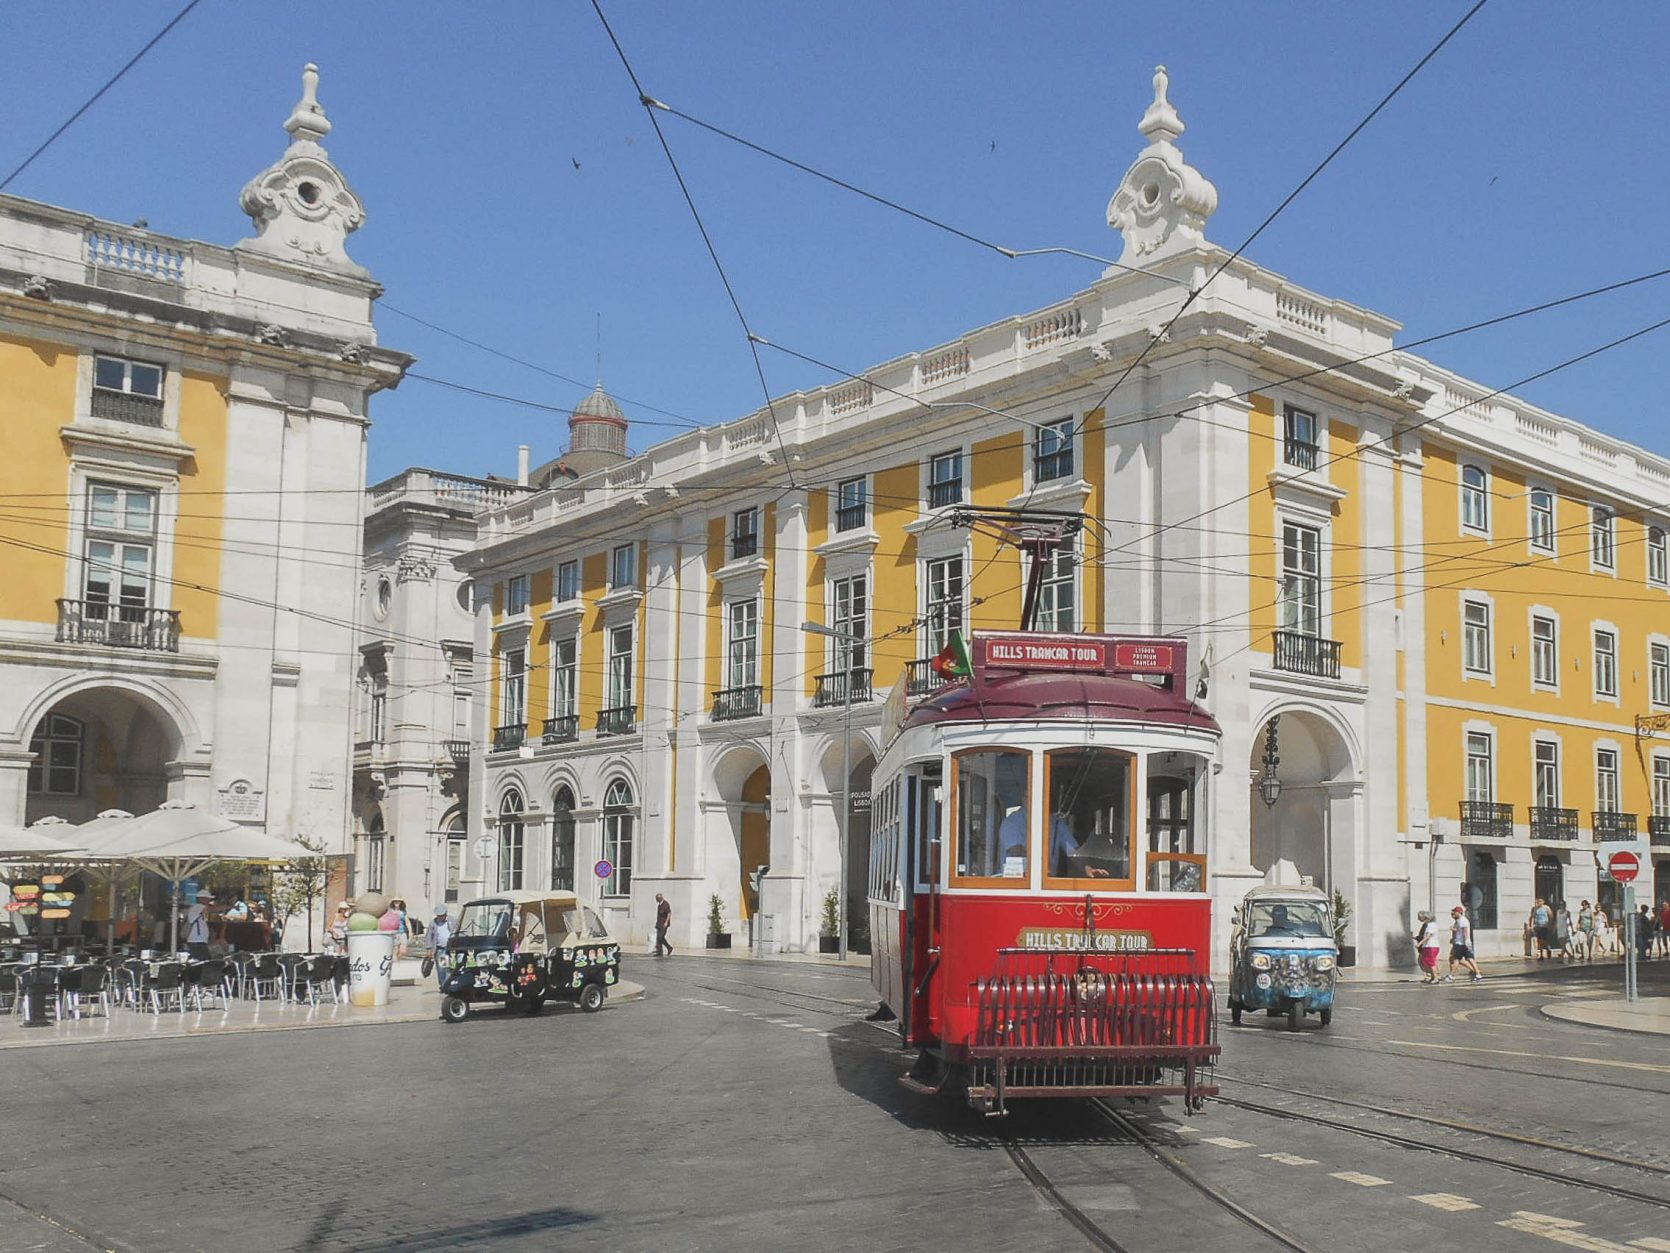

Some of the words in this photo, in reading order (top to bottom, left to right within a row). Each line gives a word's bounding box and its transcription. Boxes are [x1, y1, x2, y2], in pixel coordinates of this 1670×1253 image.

[992, 645, 1023, 659] HILLS
[1025, 646, 1069, 660] TRAMCAR
[1071, 647, 1098, 661] TOUR
[1026, 932, 1062, 949] HILLS
[1119, 934, 1148, 950] TOUR
